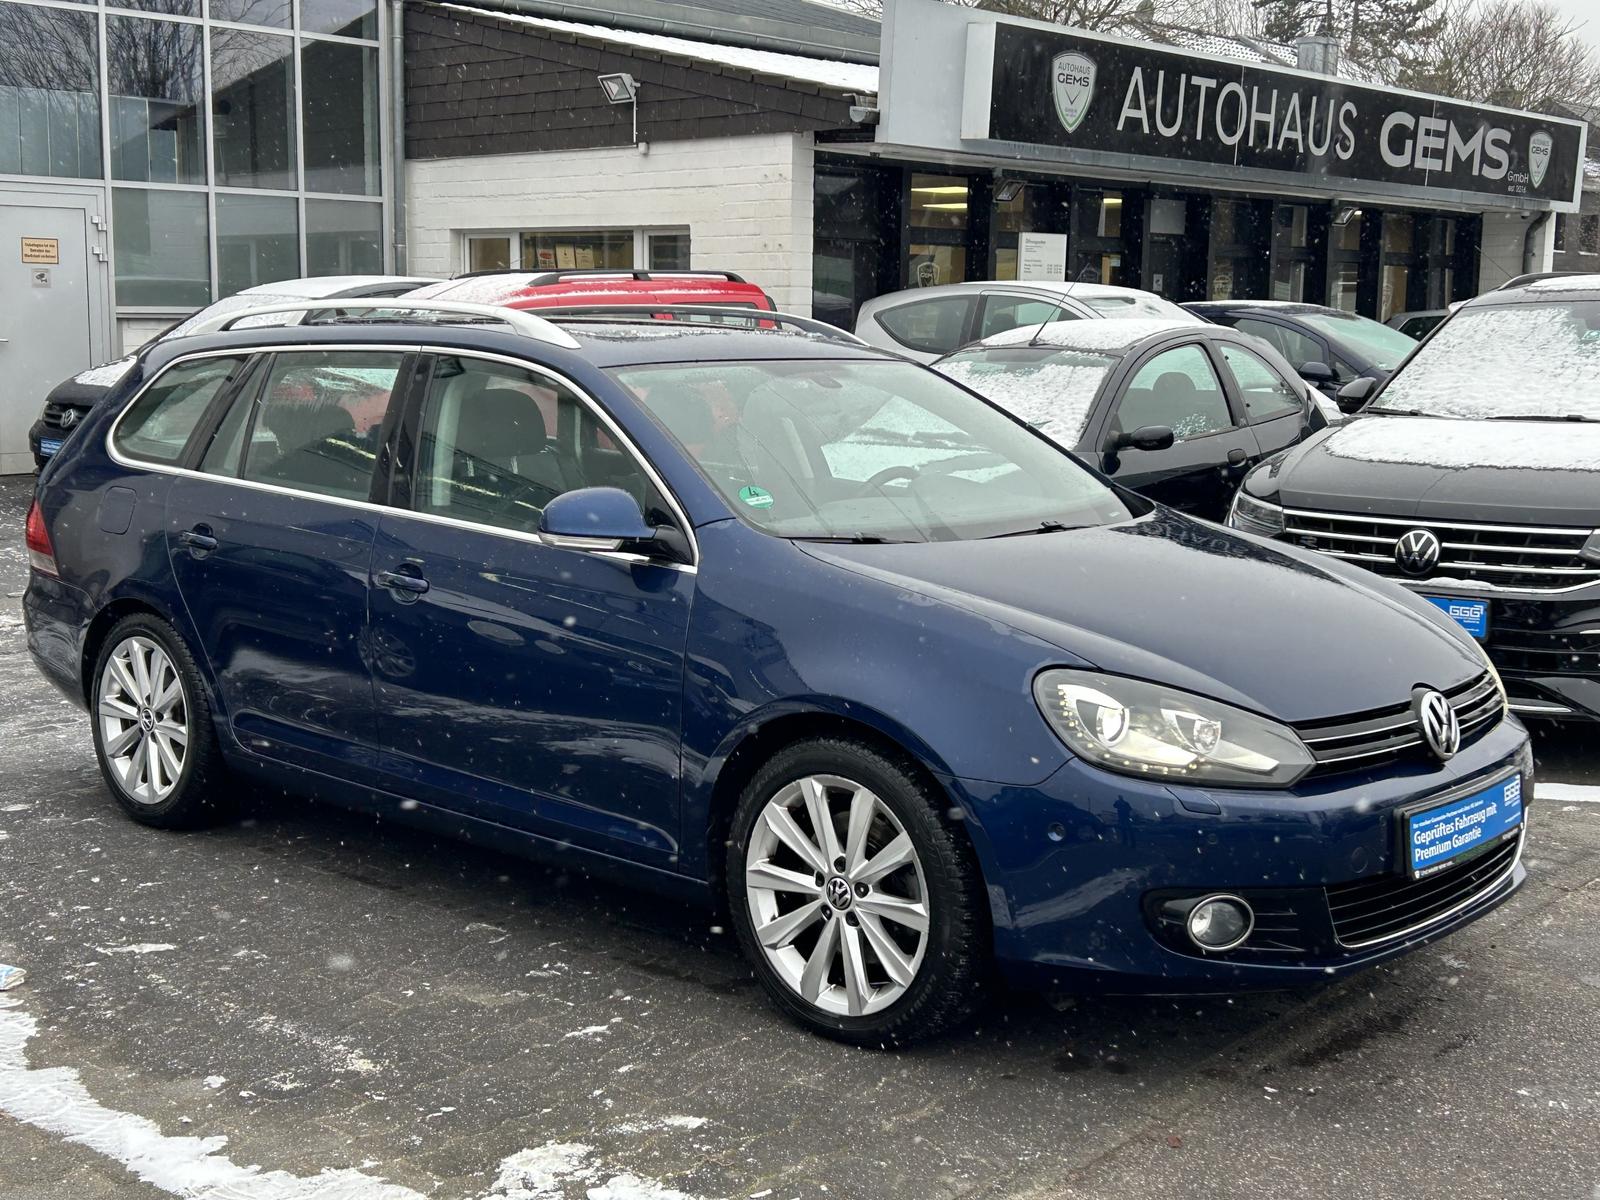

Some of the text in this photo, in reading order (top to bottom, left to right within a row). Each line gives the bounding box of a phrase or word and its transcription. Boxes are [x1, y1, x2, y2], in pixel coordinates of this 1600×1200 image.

[1058, 62, 1091, 75] AUTOHAUS
[1057, 73, 1090, 87] GEMS
[1117, 66, 1512, 179] AUTOHAUS GEMS
[1507, 170, 1529, 183] GmbH
[748, 486, 759, 497] 4
[1449, 605, 1482, 618] GGG
[1414, 822, 1454, 845] Geprüftes
[1455, 809, 1486, 831] Fahrzeug
[1486, 802, 1498, 818] mit
[1414, 841, 1451, 862] Premium
[1452, 826, 1482, 848] Garantie
